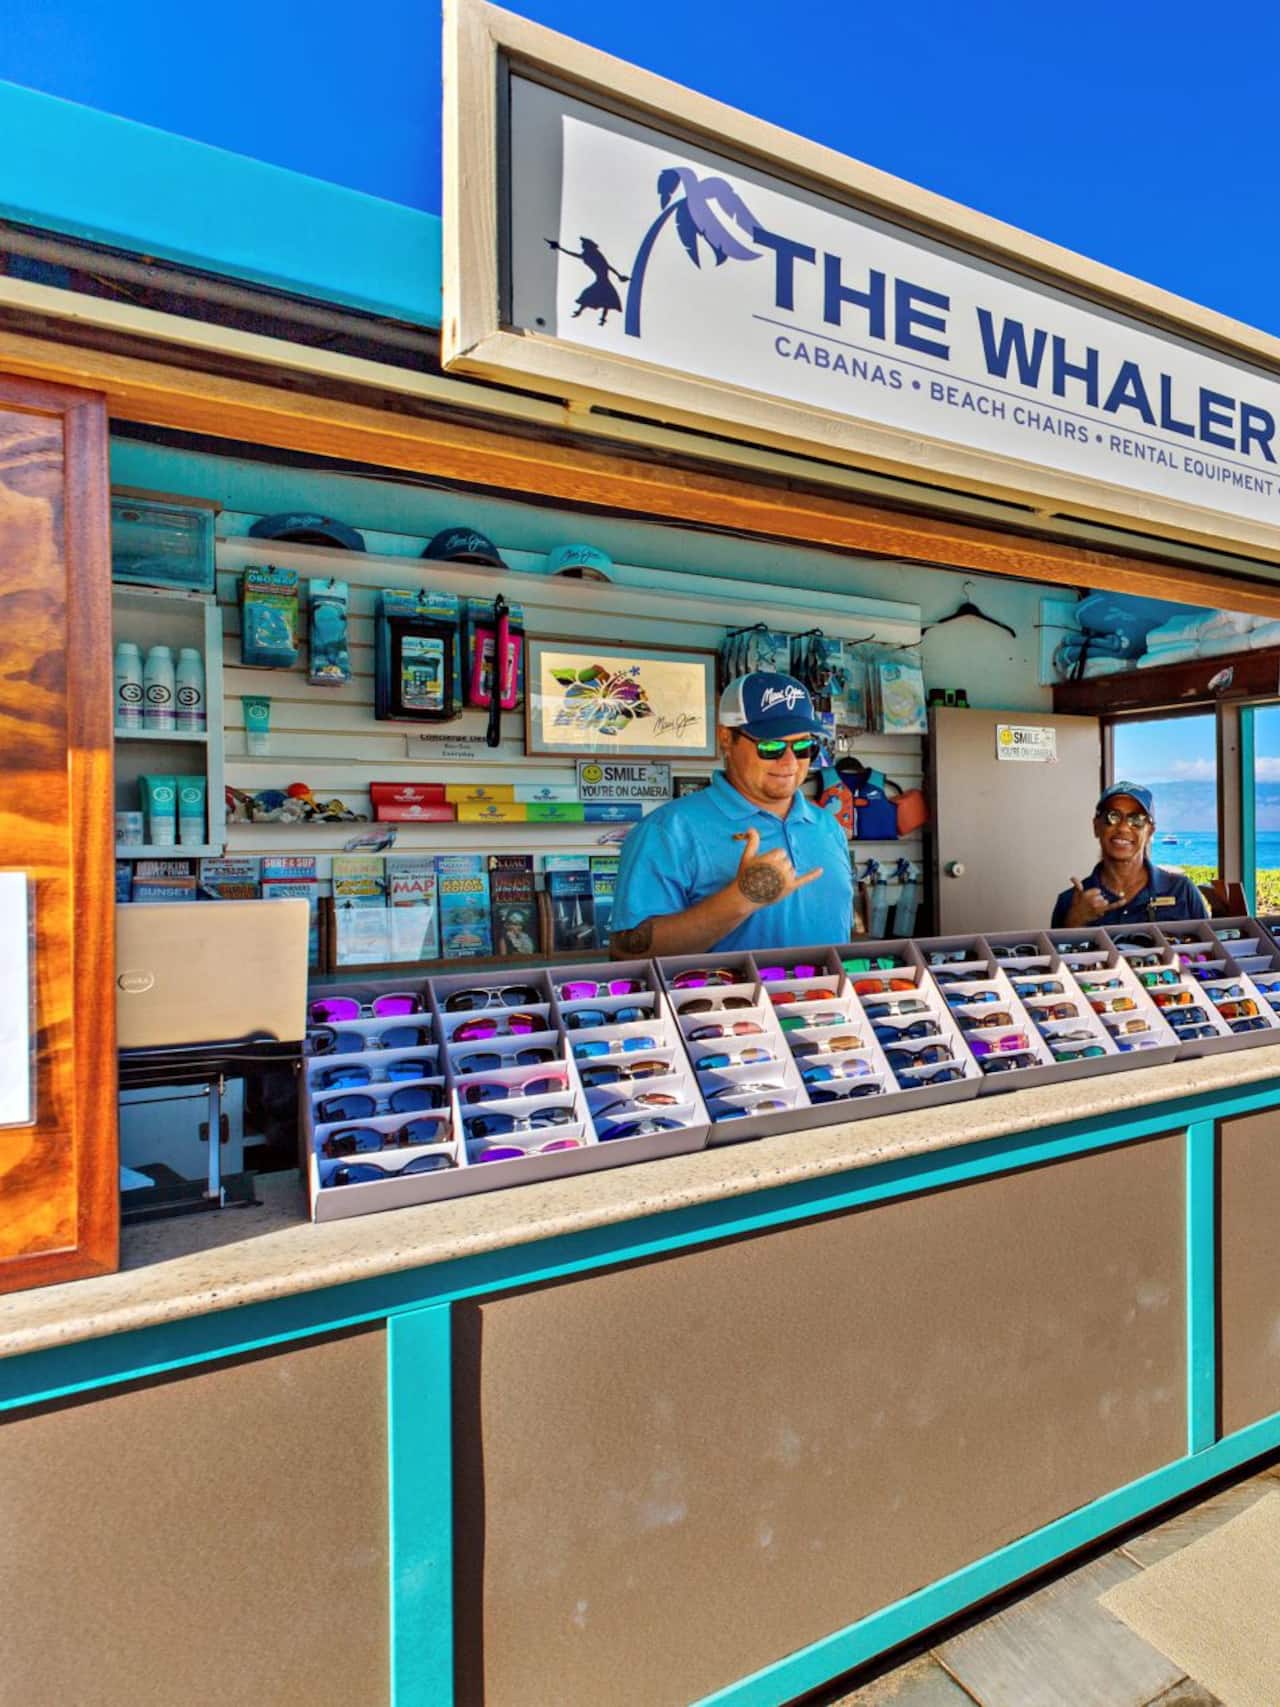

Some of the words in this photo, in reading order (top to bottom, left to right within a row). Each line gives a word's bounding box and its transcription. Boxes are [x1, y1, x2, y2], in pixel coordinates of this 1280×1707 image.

[753, 227, 950, 362] THE
[976, 307, 1277, 464] WHALER
[774, 336, 904, 391] CABANAS
[930, 381, 1006, 420] BEACH
[1013, 406, 1089, 444] CHAIRS
[1109, 435, 1179, 470] RENTAL
[1184, 457, 1273, 496] EQUIPMENT
[1014, 731, 1041, 745] SMILE
[604, 766, 648, 782] SMILE
[582, 785, 615, 797] YOU'RE
[616, 785, 630, 797] ON
[630, 785, 669, 797] CAMERA
[393, 881, 435, 893] MAP
